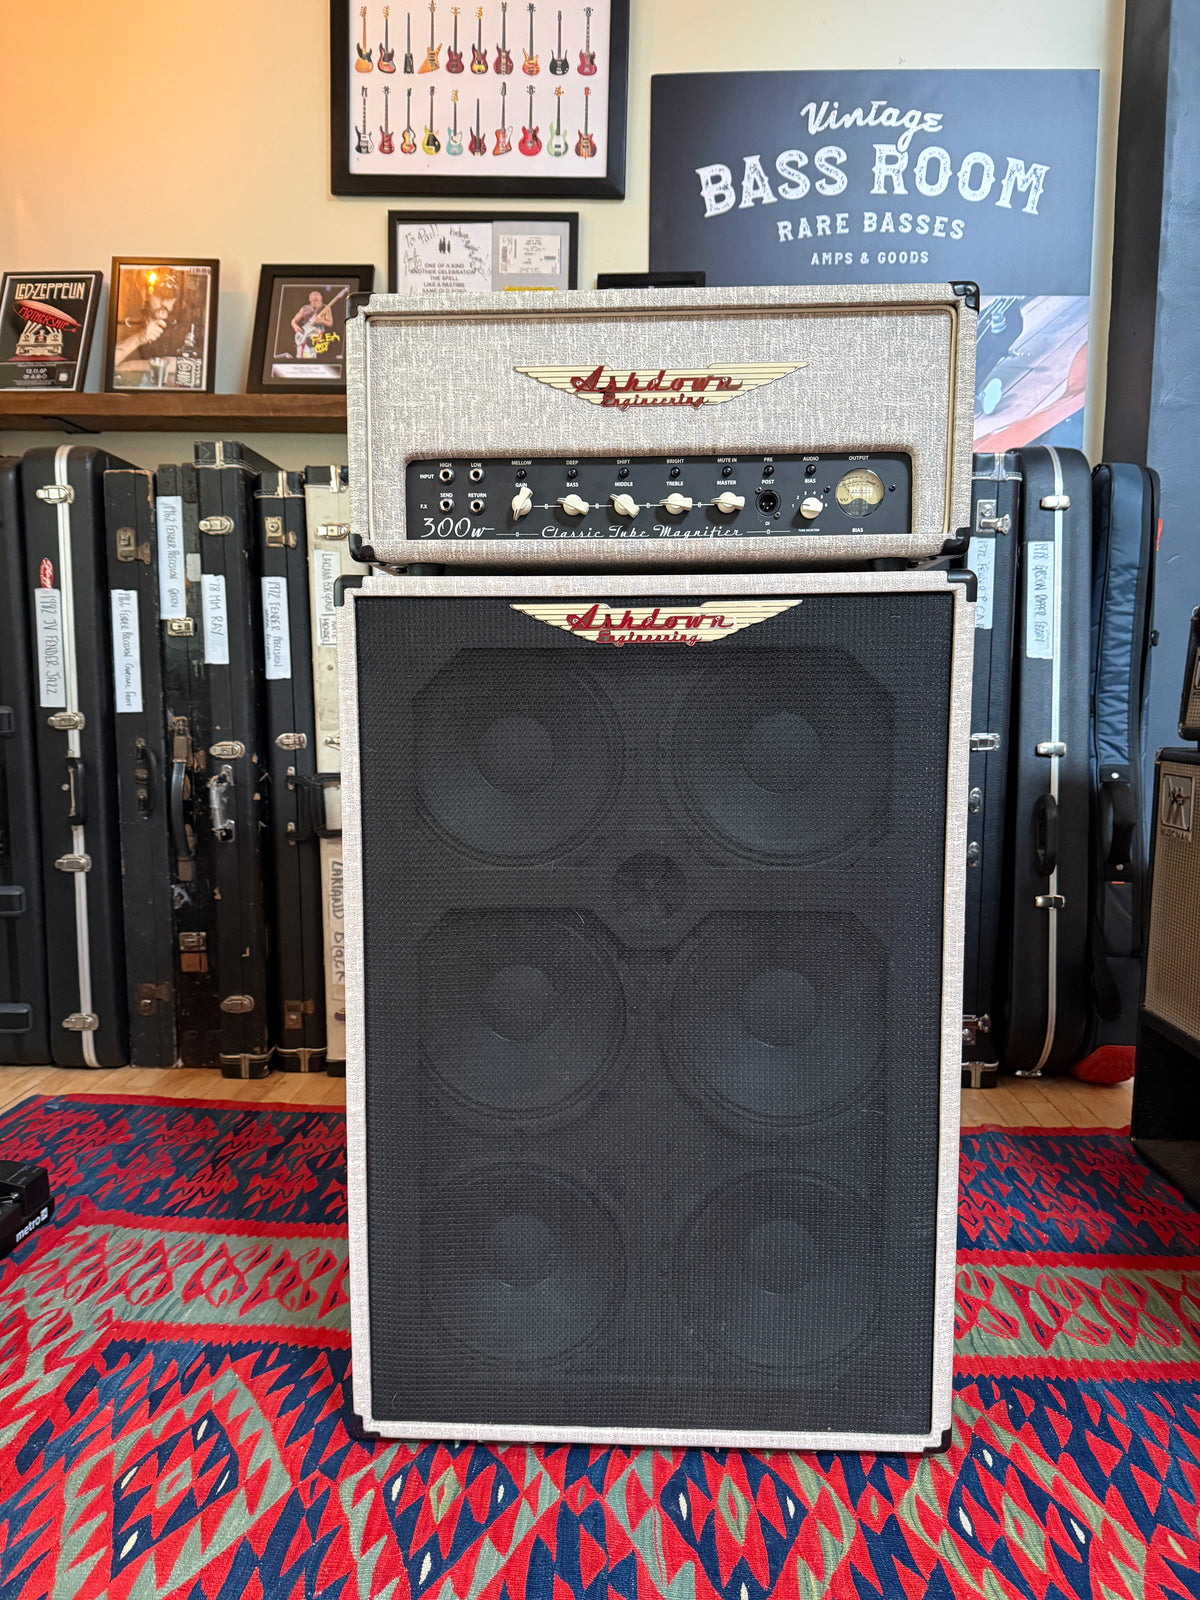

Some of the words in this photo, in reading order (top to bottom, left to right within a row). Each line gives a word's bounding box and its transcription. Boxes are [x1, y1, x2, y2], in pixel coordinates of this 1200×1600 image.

[801, 99, 943, 153] Vintage
[695, 145, 848, 218] BASS
[870, 143, 1051, 215] ROOM
[777, 213, 850, 243] RARE
[863, 211, 965, 239] BASSES
[810, 252, 853, 266] AMPS
[859, 251, 870, 265] &
[877, 251, 930, 265] GOODS
[18, 306, 70, 330] MOTHERSHIP
[310, 331, 340, 346] FLEA
[570, 365, 743, 393] Ashdown
[600, 392, 709, 410] Engineering
[541, 525, 604, 538] Classic
[608, 525, 650, 538] Tube
[653, 524, 743, 540] Magnifier
[266, 581, 281, 598] 1972
[40, 595, 56, 613] 1982
[208, 594, 221, 609] MM
[43, 619, 58, 631] JV
[210, 615, 224, 636] RAY
[268, 602, 281, 632] FENDER
[566, 604, 736, 631] Ashdown
[596, 630, 701, 646] Engineering
[44, 635, 60, 667] FENDER
[46, 671, 60, 695] JAZZ
[16, 1215, 41, 1243] metro
